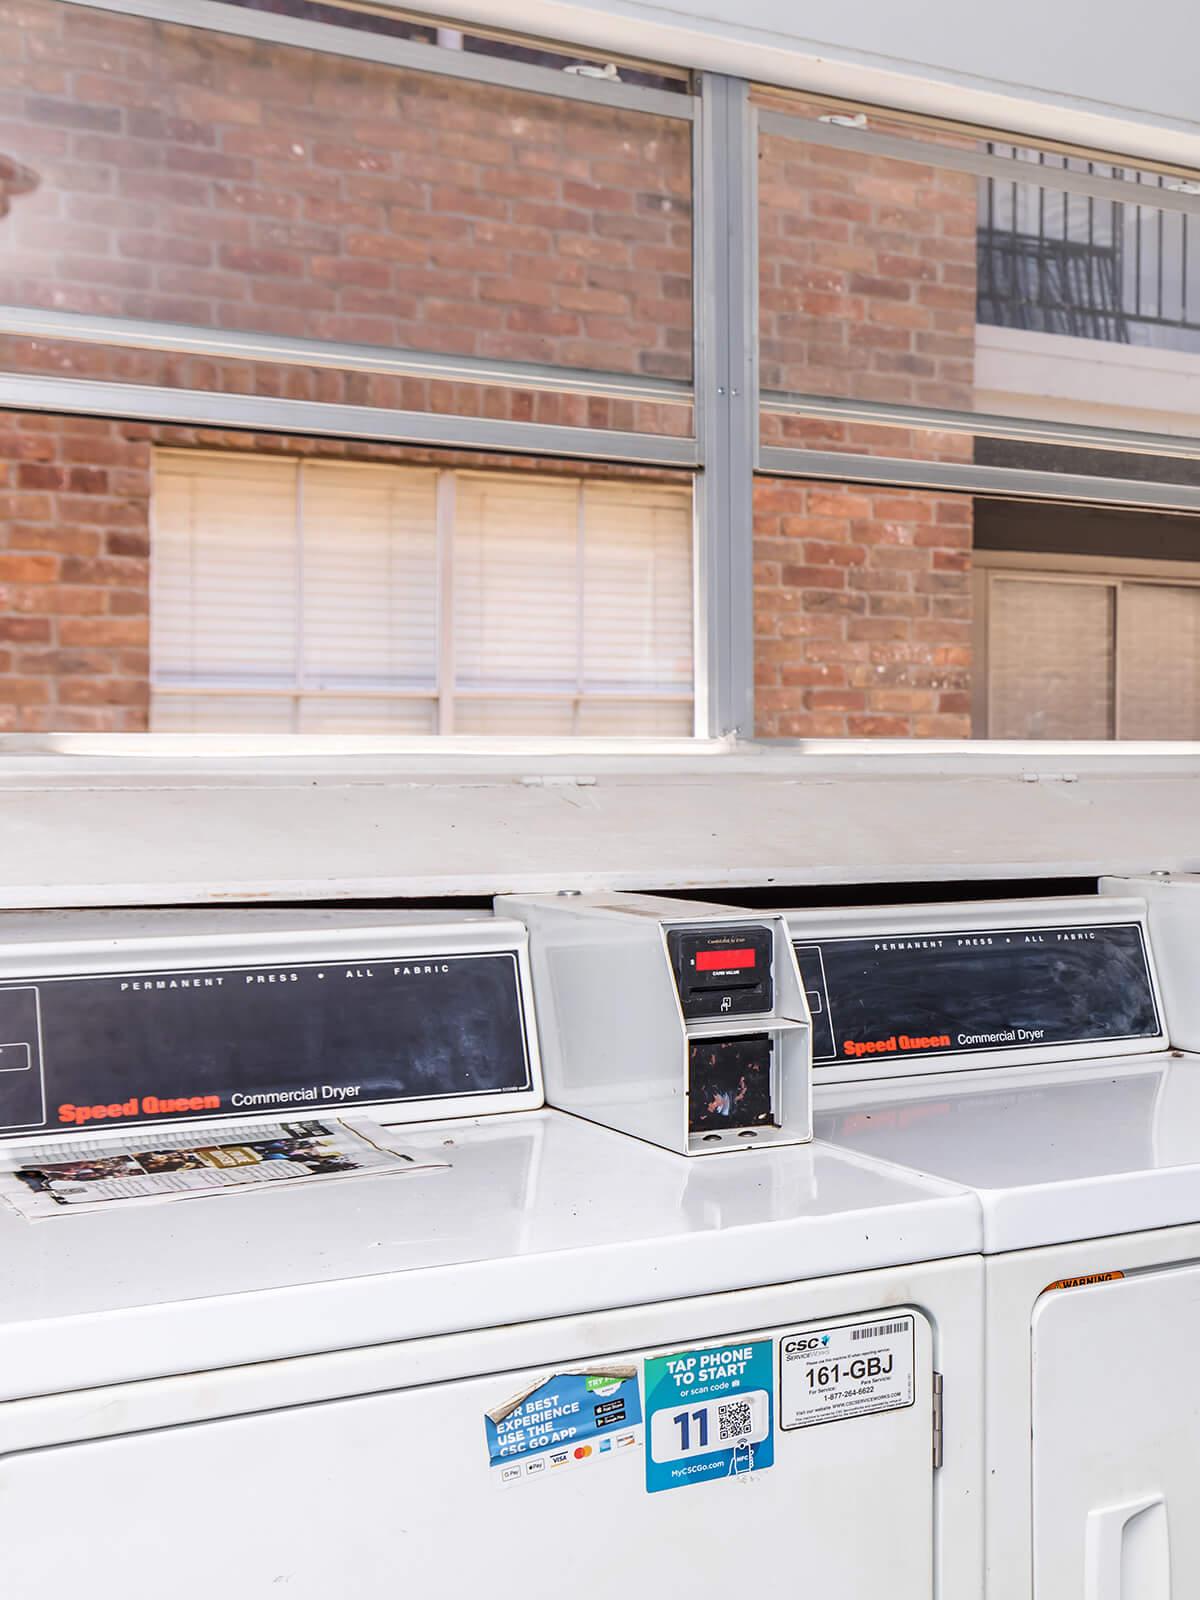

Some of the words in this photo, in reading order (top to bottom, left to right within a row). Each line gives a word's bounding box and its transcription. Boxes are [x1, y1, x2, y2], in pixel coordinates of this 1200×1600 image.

[874, 940, 944, 951] PERMANENT
[957, 937, 993, 946] PRESS
[1024, 934, 1045, 943] ALL
[1056, 932, 1096, 941] FABRIC
[120, 977, 224, 991] PERMANENT
[246, 972, 299, 984] PRESS
[346, 968, 374, 978] ALL
[394, 964, 450, 976] FABRIC
[843, 1036, 897, 1057] Speed
[899, 1034, 950, 1051] Queen
[957, 1030, 1016, 1045] Commercial
[1017, 1028, 1044, 1042] Dryer
[57, 1098, 139, 1125] Speed
[142, 1095, 221, 1114] Queen
[231, 1087, 318, 1107] Commercial
[321, 1084, 361, 1103] Dryer
[1062, 1273, 1112, 1288] WARNING
[785, 1337, 819, 1353] CSC
[666, 1357, 696, 1374] TAP
[700, 1348, 753, 1369] PHONE
[806, 1354, 893, 1388] 161-GBJ
[673, 1373, 695, 1386] TO
[698, 1361, 747, 1382] START
[691, 1386, 709, 1396] scan
[710, 1381, 729, 1392] code
[824, 1386, 874, 1401] 1-877-264-6622
[526, 1395, 560, 1414] BEST
[496, 1402, 580, 1434] EXPERIENCE
[673, 1407, 708, 1450] 11
[497, 1430, 526, 1446] USE
[528, 1422, 554, 1438] THE
[500, 1442, 526, 1457] CSC
[529, 1434, 550, 1449] GO
[551, 1427, 577, 1443] APP
[552, 1455, 567, 1464] VISA
[671, 1460, 725, 1478] MyCSCGo.com
